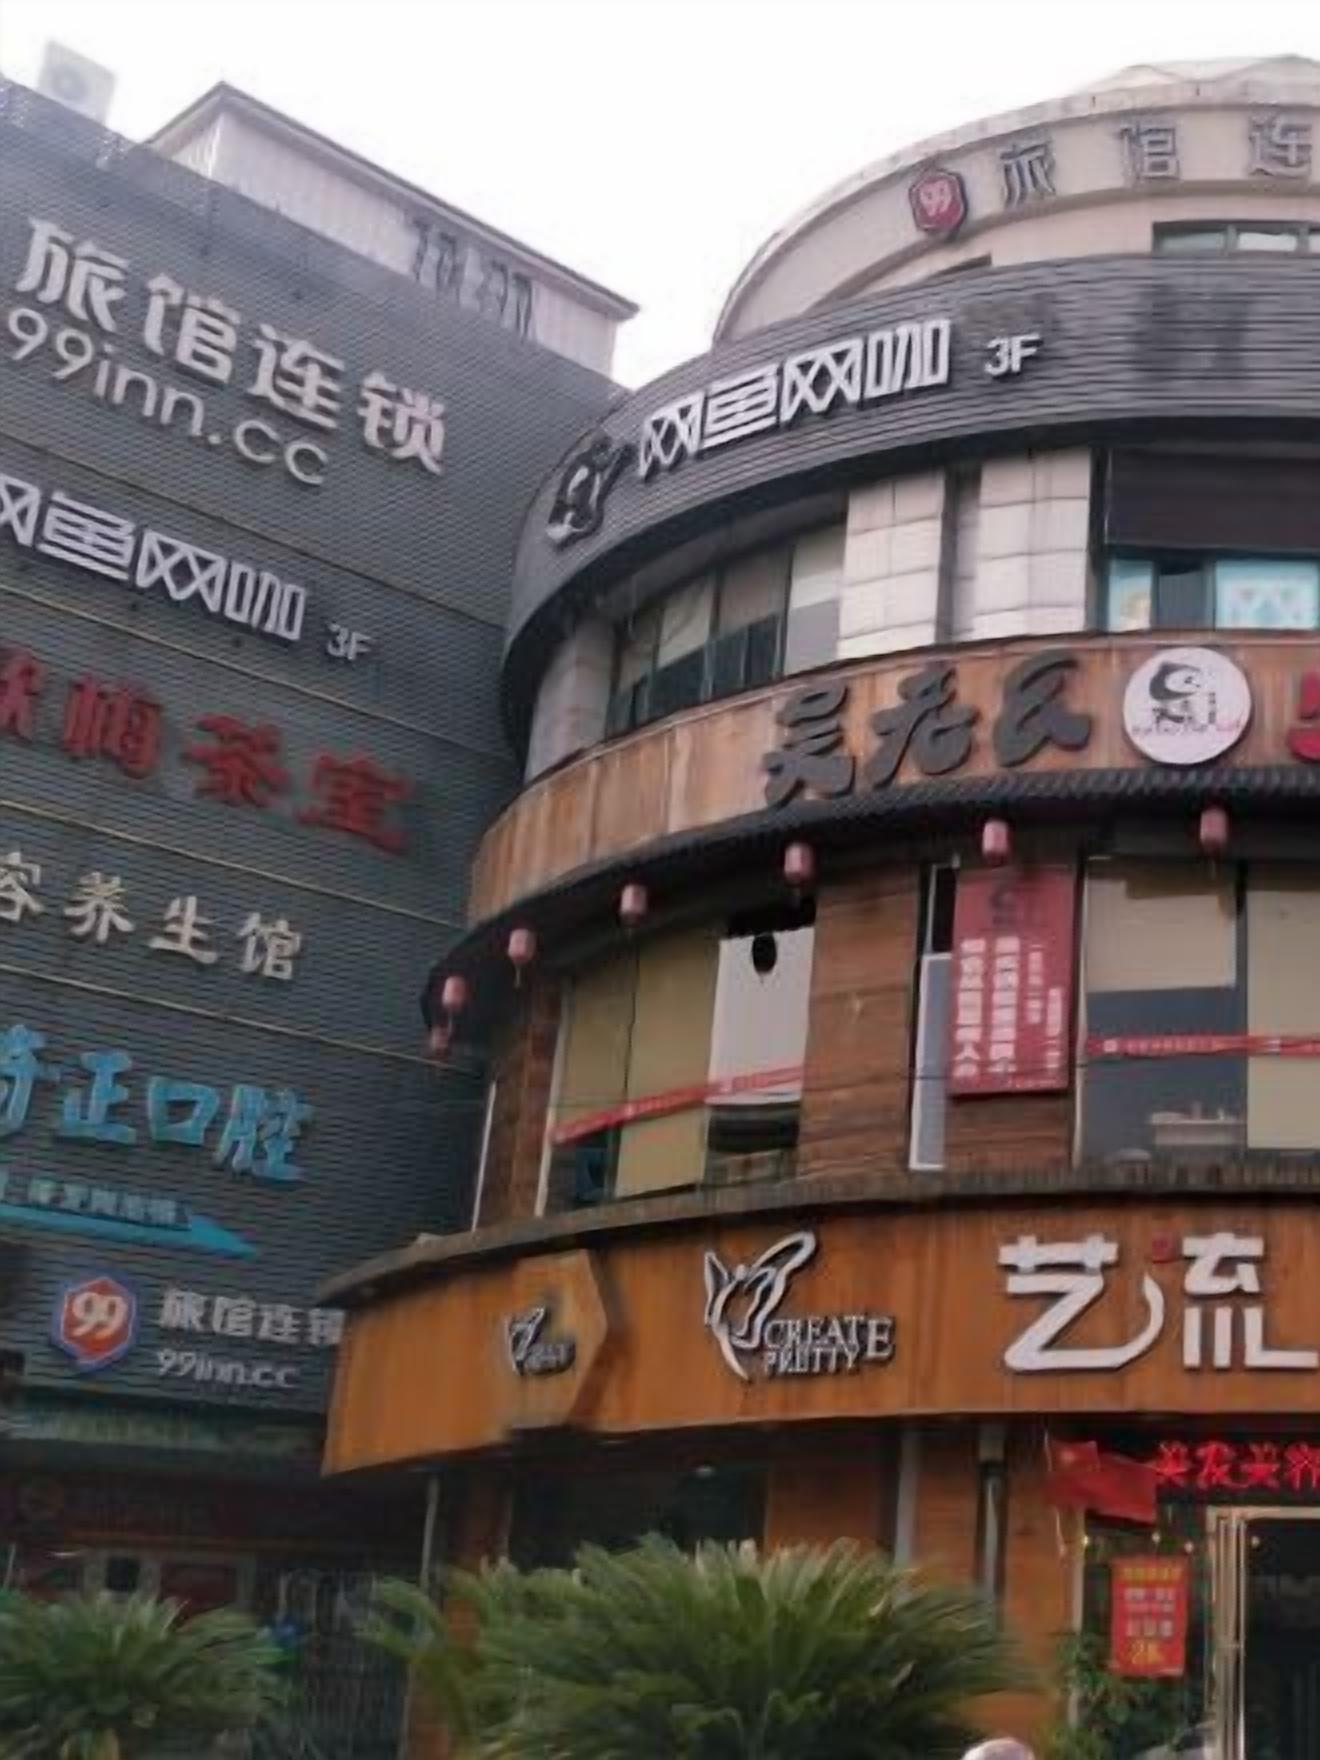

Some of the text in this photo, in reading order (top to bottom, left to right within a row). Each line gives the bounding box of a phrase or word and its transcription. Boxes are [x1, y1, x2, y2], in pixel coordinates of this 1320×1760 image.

[6, 306, 330, 487] 99inn.cc
[14, 216, 447, 477] 旅馆连锁
[639, 318, 1043, 480] 网鱼网咖 3F
[325, 622, 374, 662] 3F
[0, 851, 304, 982] 容养生馆
[67, 1291, 129, 1338] 99
[763, 1314, 894, 1359] CREATE
